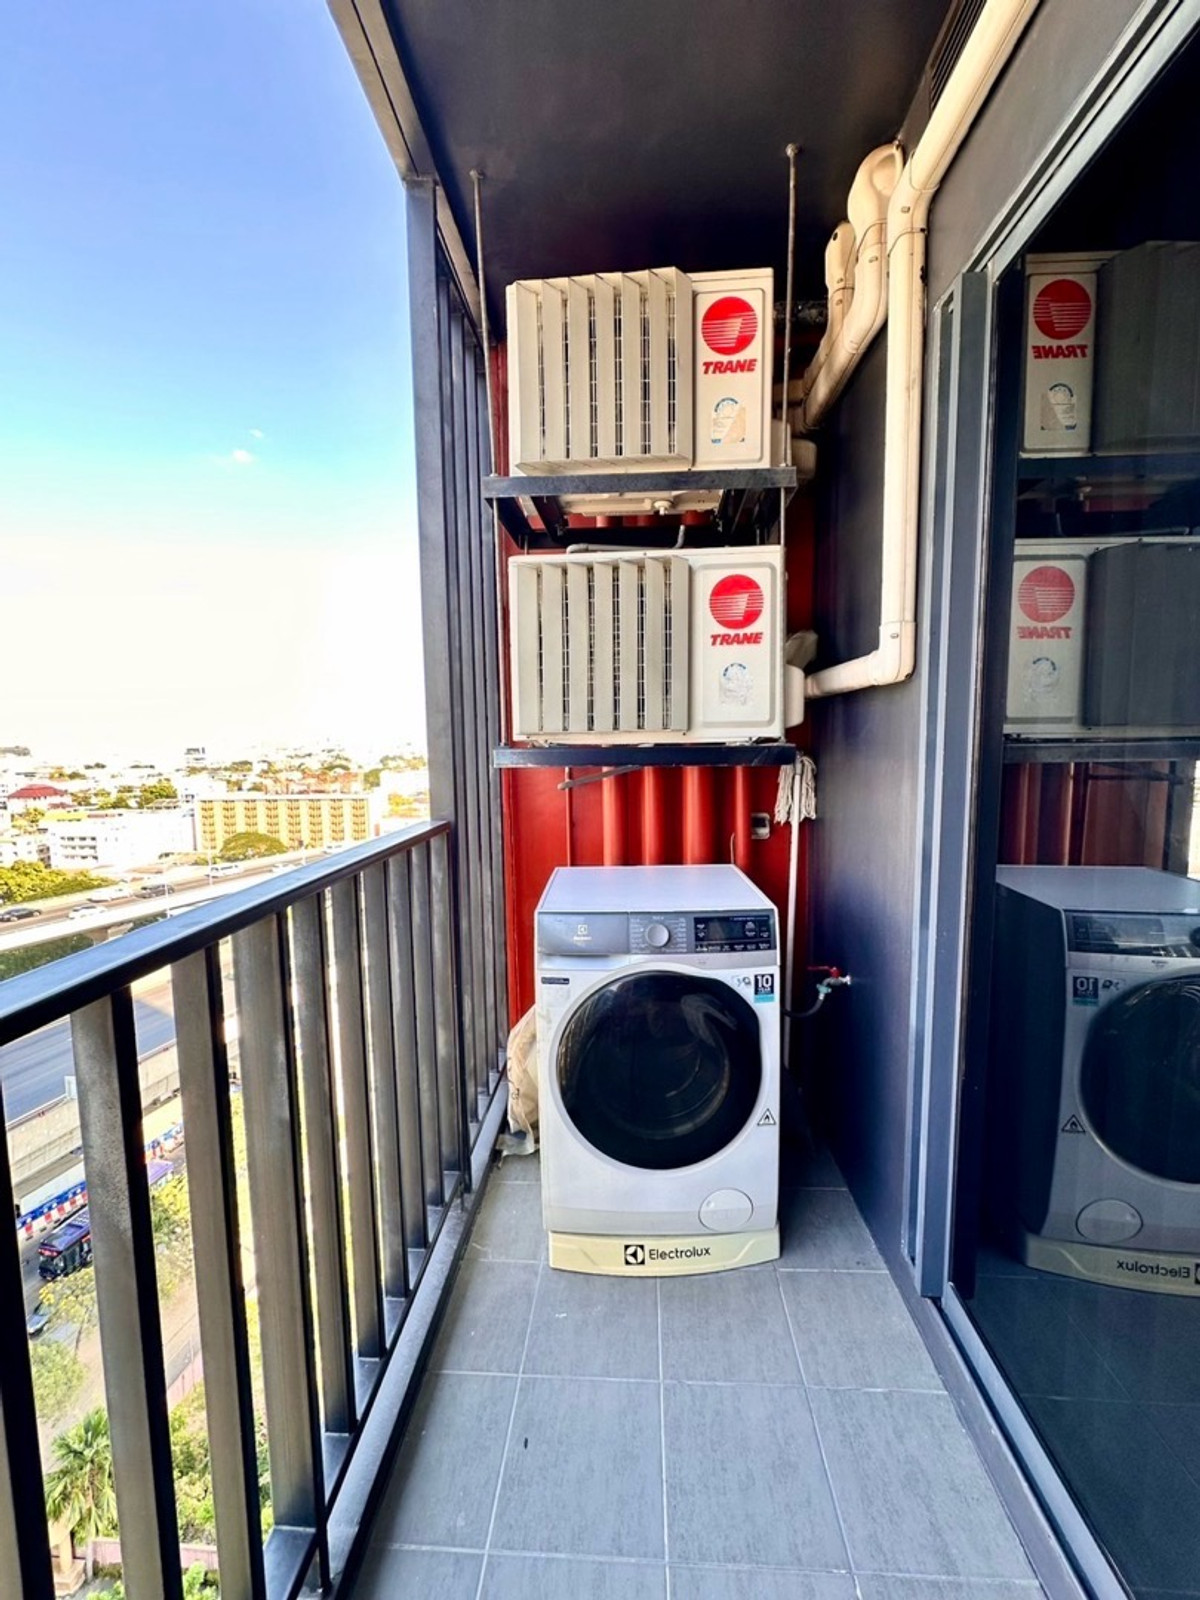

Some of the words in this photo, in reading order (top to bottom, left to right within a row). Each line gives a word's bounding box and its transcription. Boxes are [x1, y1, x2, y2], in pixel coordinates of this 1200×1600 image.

[703, 358, 757, 375] TRANE
[710, 631, 763, 646] TRANE
[757, 975, 772, 988] 10
[648, 1245, 711, 1261] Electrolux
